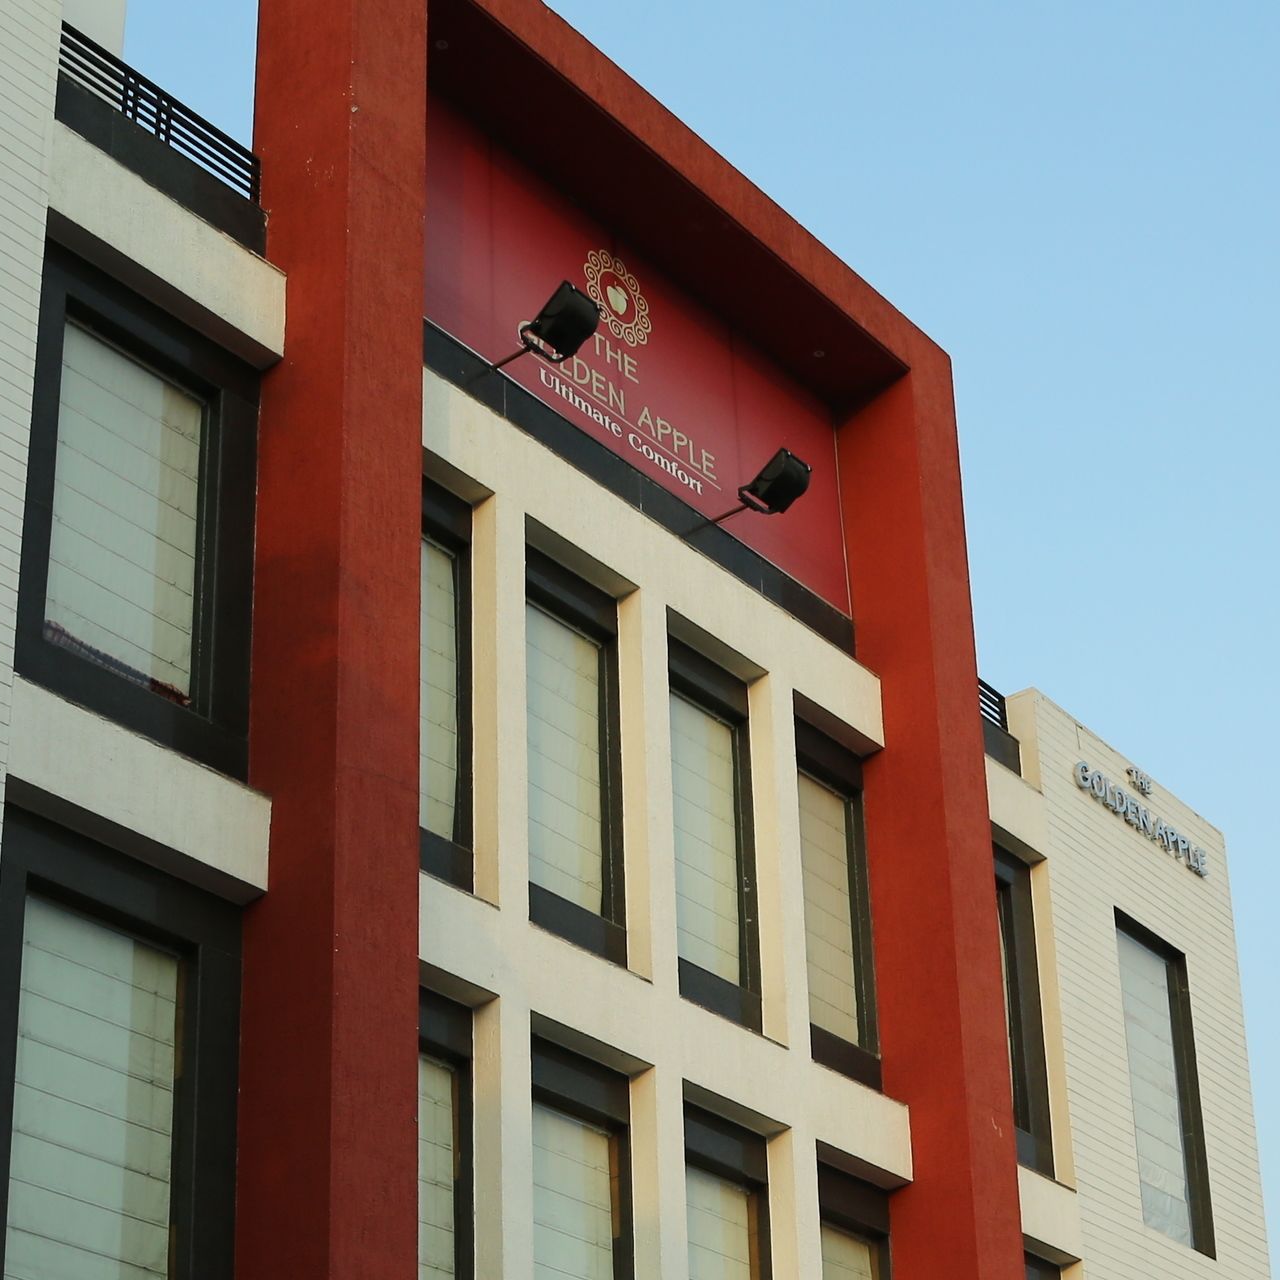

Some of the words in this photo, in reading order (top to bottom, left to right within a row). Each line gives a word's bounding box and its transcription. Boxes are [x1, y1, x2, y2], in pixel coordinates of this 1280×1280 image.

[594, 331, 640, 385] THE
[538, 366, 623, 438] Ultimate
[628, 433, 704, 496] Comfort
[636, 405, 718, 481] APPLE
[1073, 760, 1157, 841] GOLDEN
[1152, 816, 1208, 878] APPLE
